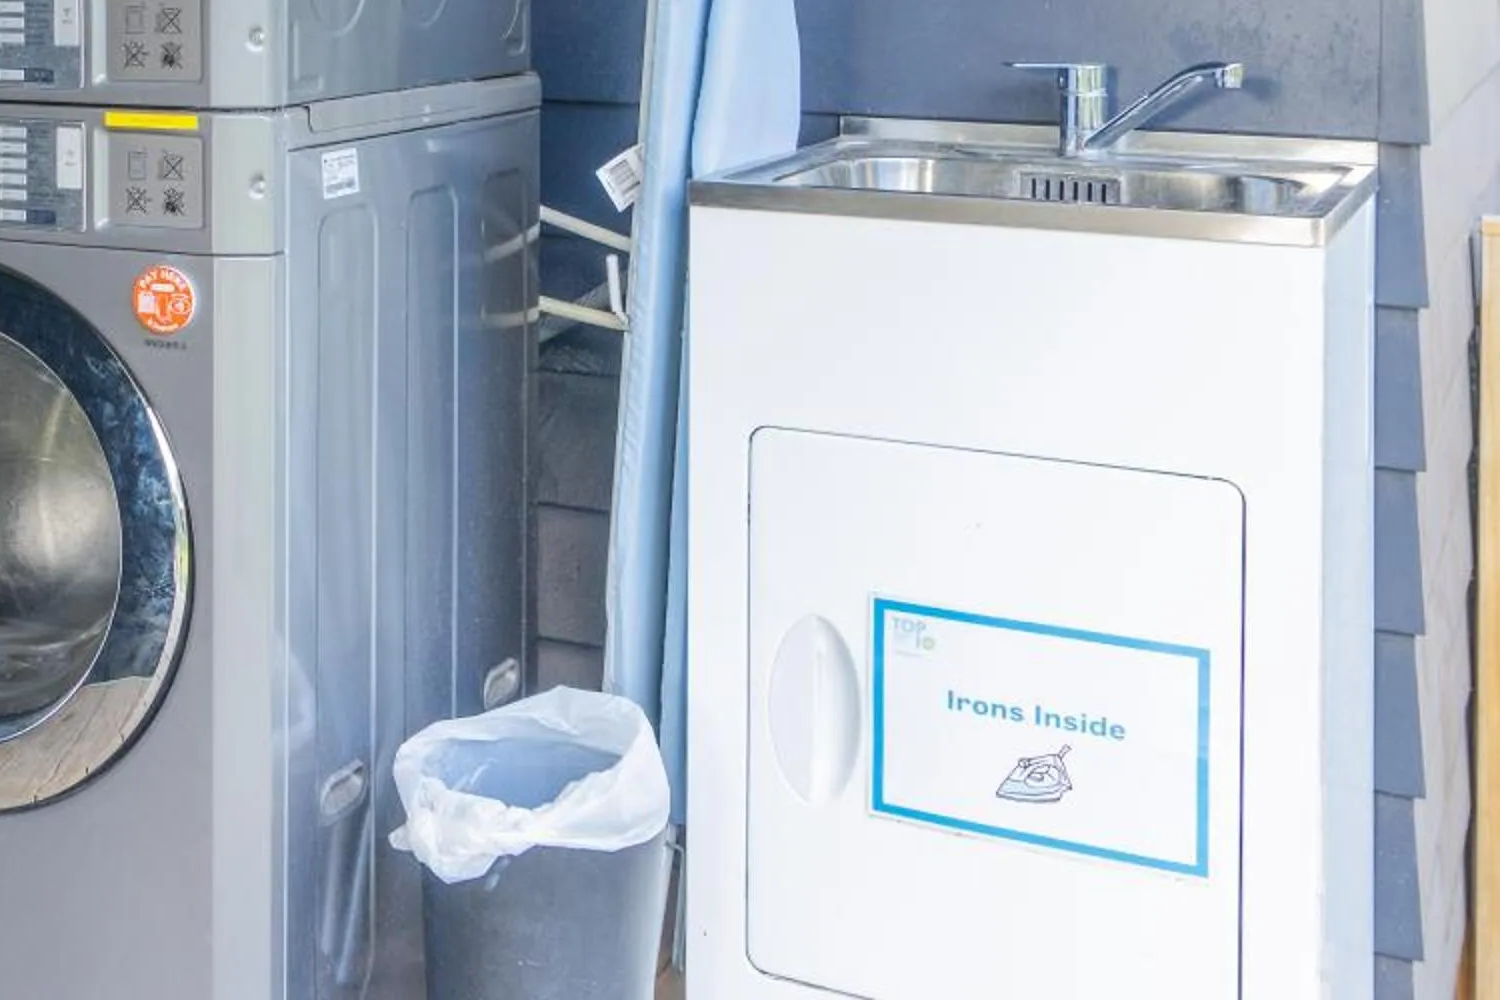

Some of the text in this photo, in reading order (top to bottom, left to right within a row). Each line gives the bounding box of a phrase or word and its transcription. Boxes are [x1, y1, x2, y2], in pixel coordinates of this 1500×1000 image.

[891, 617, 927, 634] TOP
[947, 690, 1127, 741] Irons Inside
